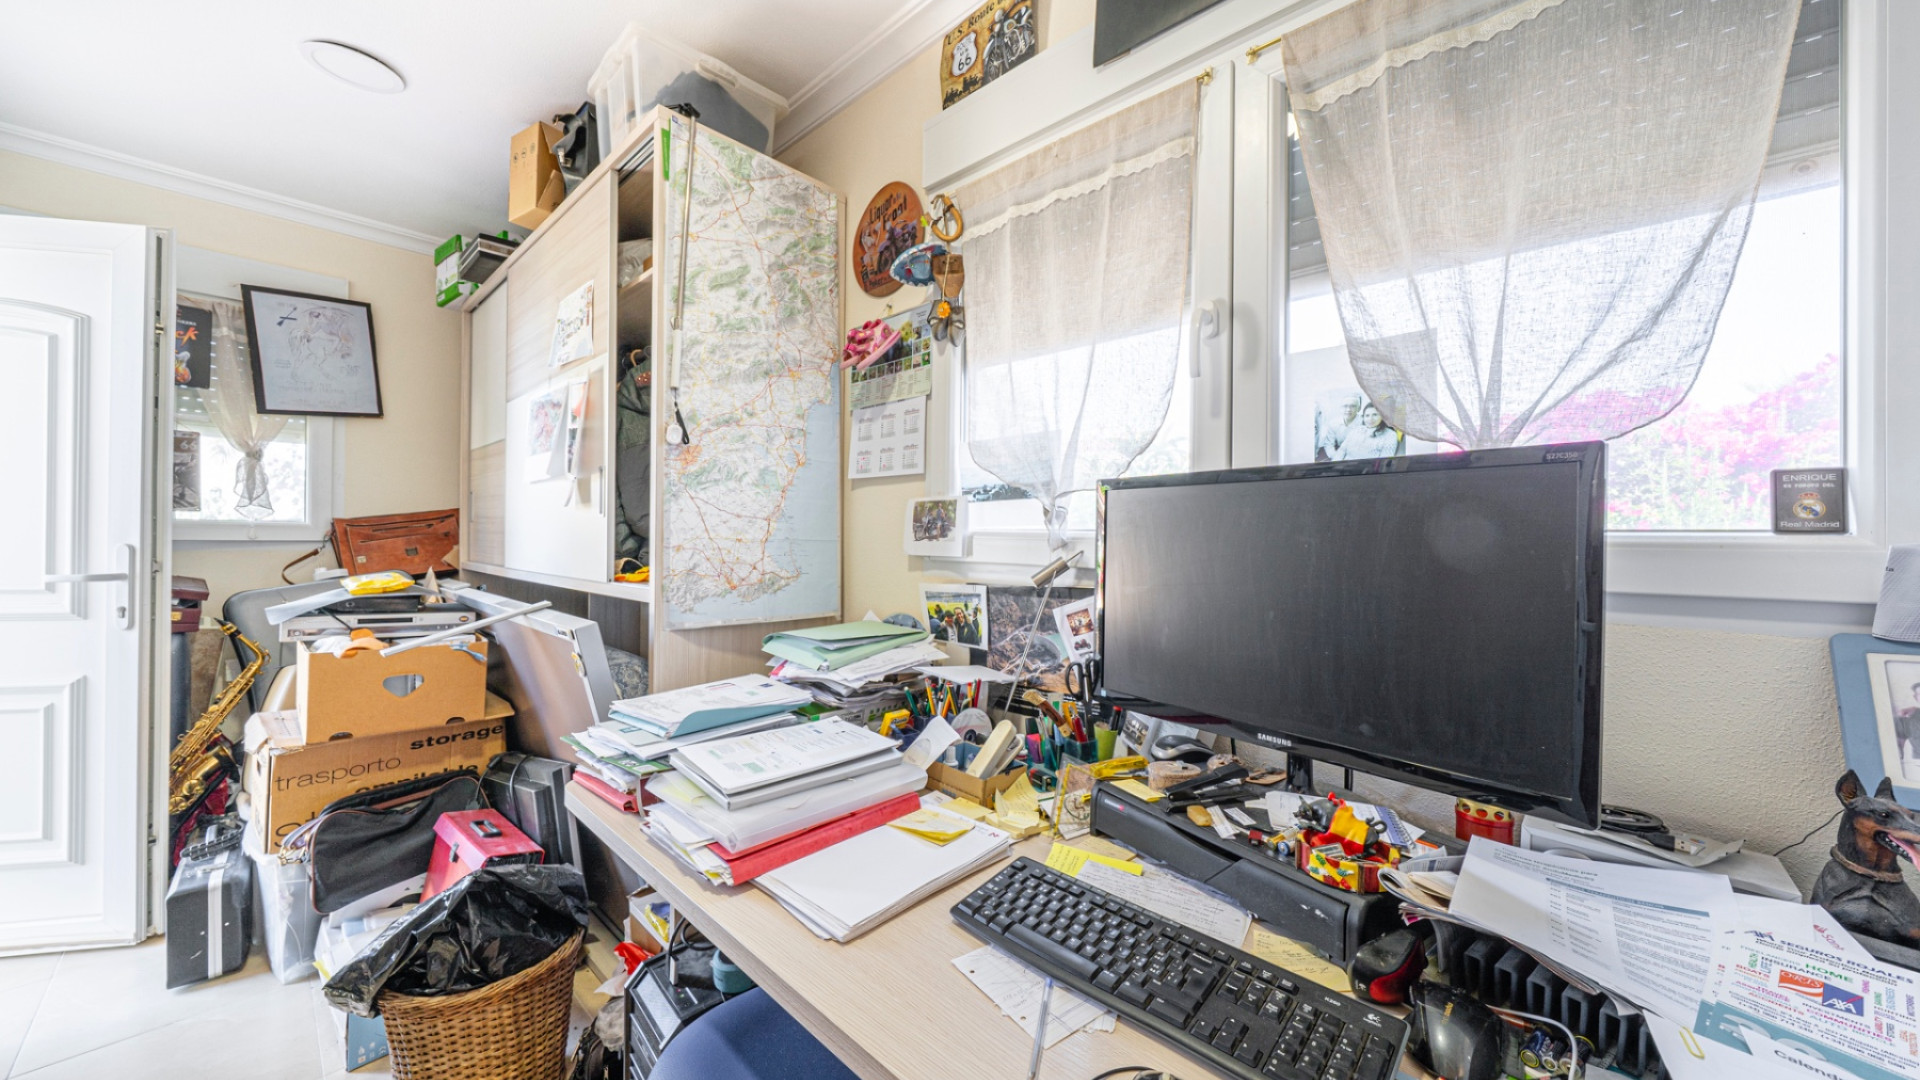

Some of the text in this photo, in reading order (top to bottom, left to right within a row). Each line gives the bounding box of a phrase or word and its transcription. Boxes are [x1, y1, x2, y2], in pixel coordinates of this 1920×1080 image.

[968, 3, 998, 28] Route
[958, 54, 972, 71] 66
[1782, 473, 1837, 482] ENRIQUE
[410, 724, 504, 750] storage
[1257, 732, 1292, 747] SAMSUNG
[275, 756, 402, 793] trasporto
[1761, 956, 1832, 981] INSURANCE
[1779, 939, 1842, 961] SEGUROS
[1846, 959, 1913, 984] ROJALES
[1805, 962, 1853, 983] HOME
[1821, 997, 1857, 1015] AXA
[1774, 1050, 1844, 1080] Calend
